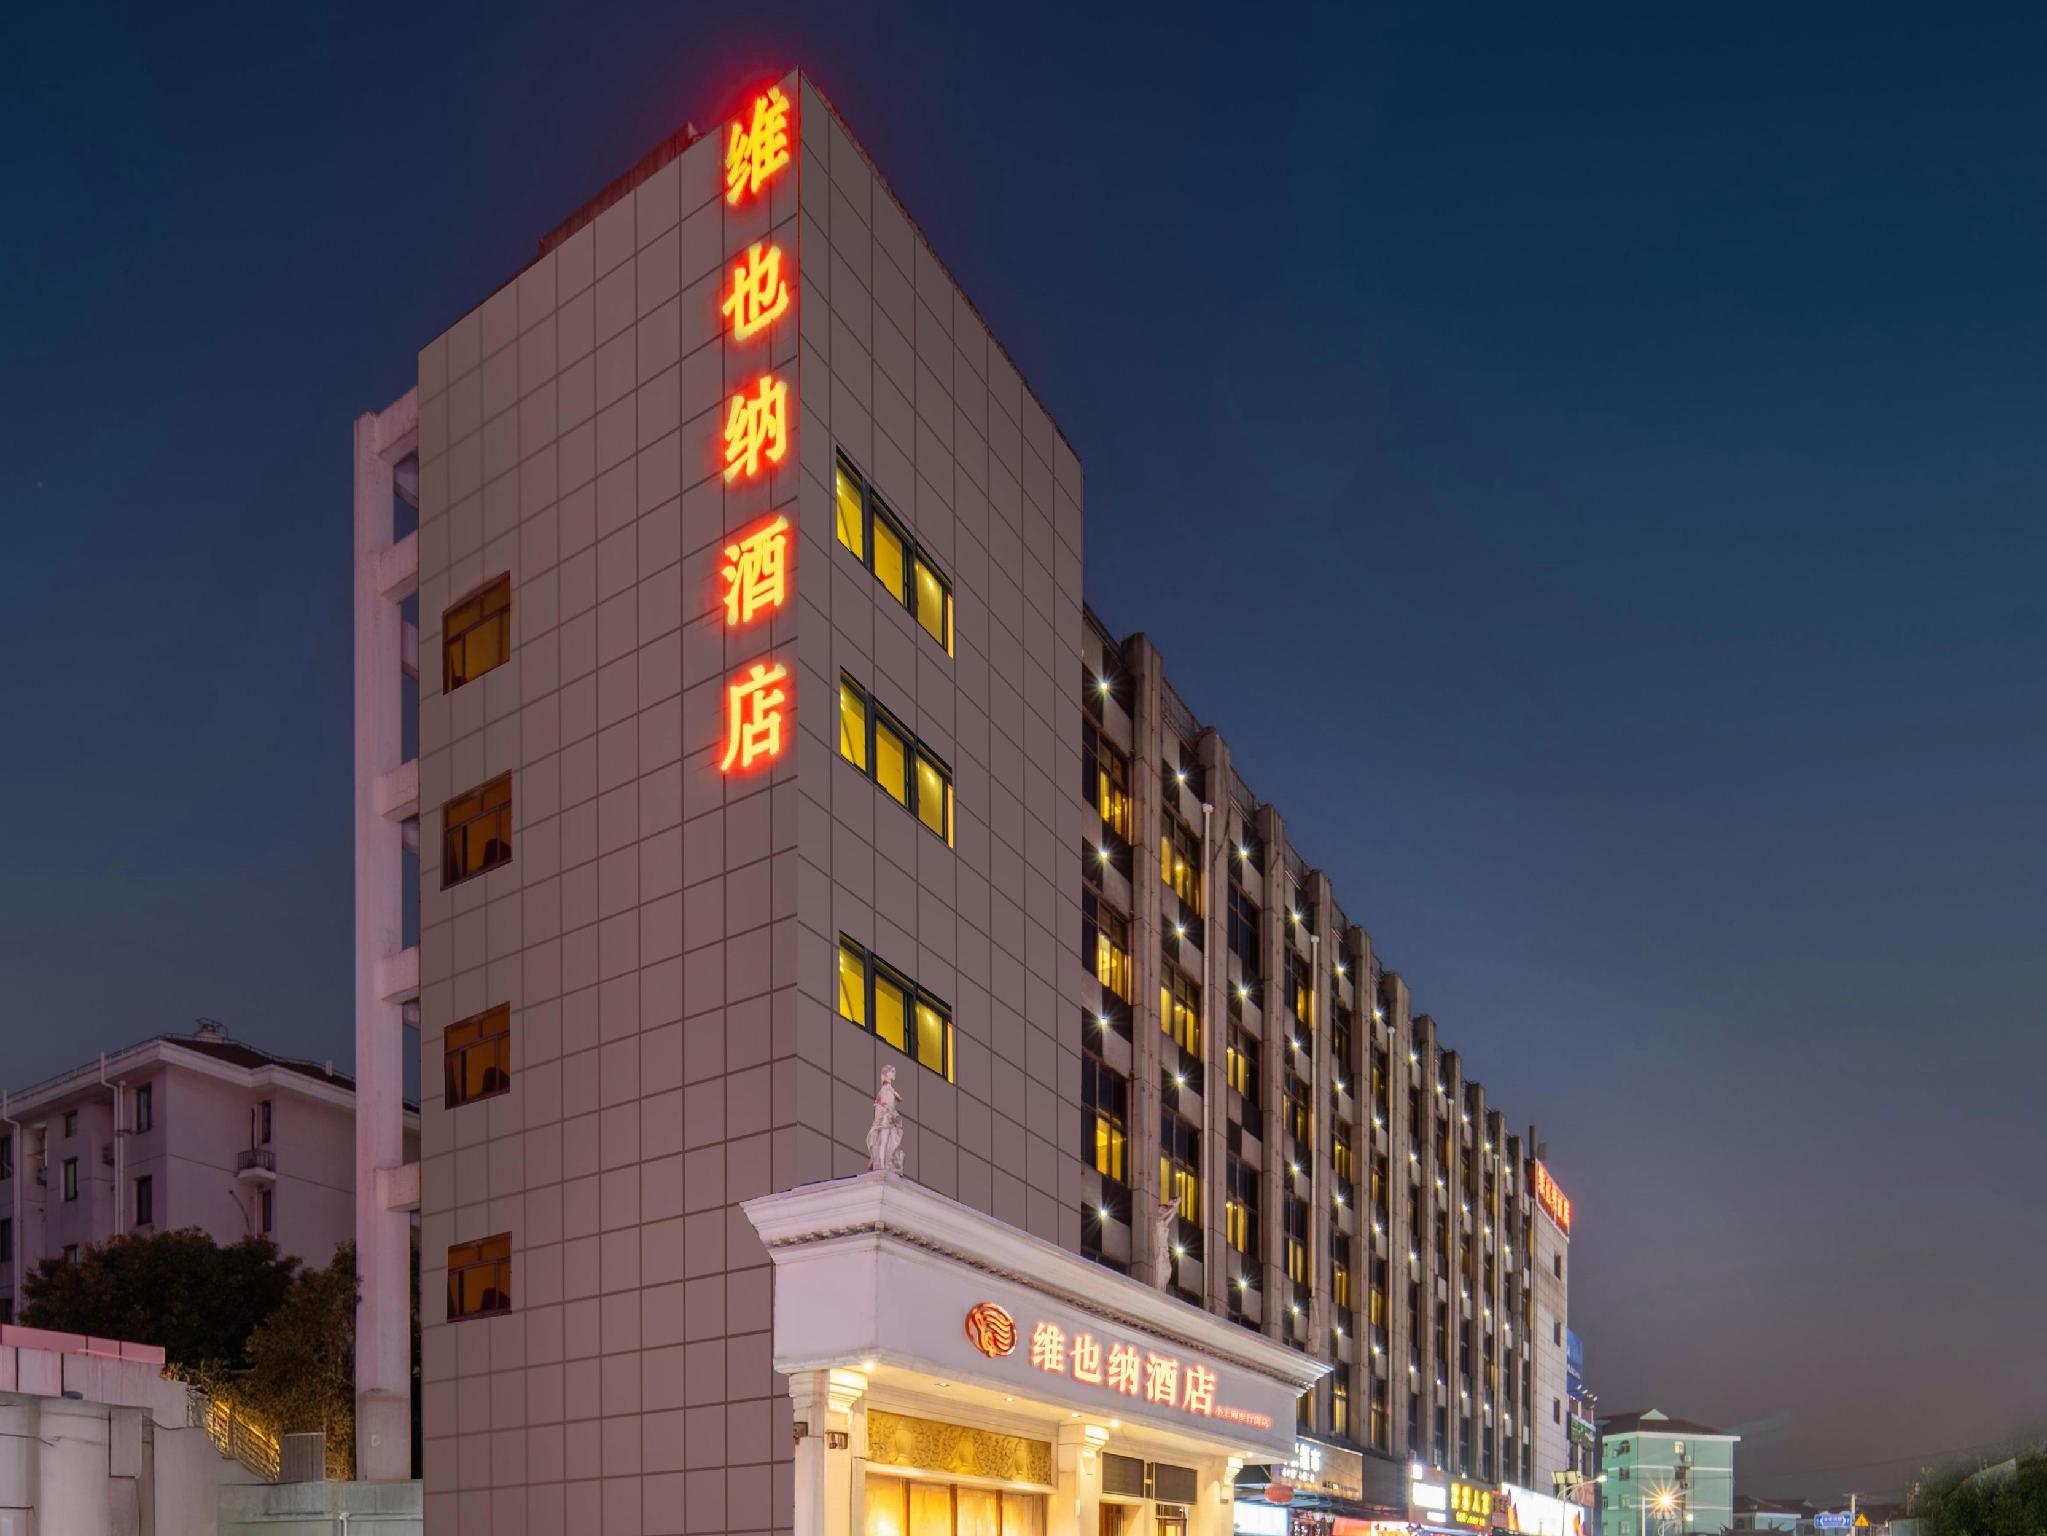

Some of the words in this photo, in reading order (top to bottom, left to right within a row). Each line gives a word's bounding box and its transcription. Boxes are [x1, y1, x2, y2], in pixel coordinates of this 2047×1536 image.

[721, 86, 789, 771] 维也纳酒店
[1032, 1321, 1216, 1415] 维也纳酒店
